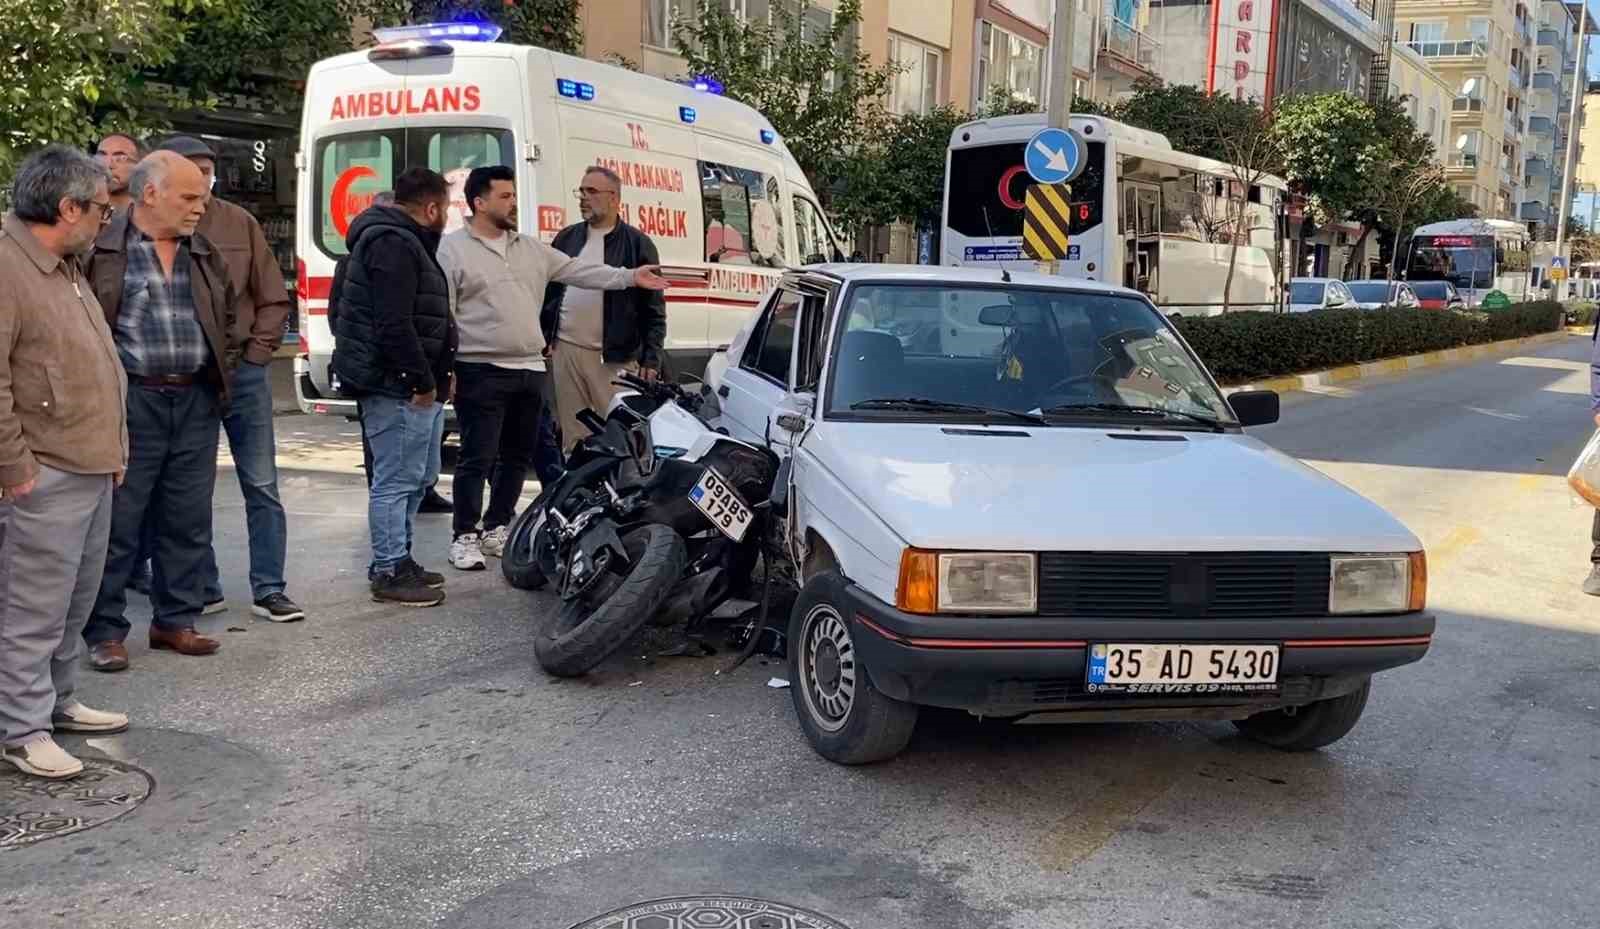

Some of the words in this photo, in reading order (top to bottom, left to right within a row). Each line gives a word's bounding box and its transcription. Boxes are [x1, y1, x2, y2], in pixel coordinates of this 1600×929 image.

[330, 85, 481, 120] AMBULANS
[626, 122, 649, 149] T.C.
[542, 210, 562, 230] 112
[639, 201, 688, 238] SAĞLIK
[705, 476, 748, 523] 09ABS
[706, 498, 732, 528] 179
[1092, 666, 1104, 676] TR
[1109, 649, 1142, 679] 35
[1159, 649, 1192, 679] AD
[1209, 650, 1274, 679] 5430
